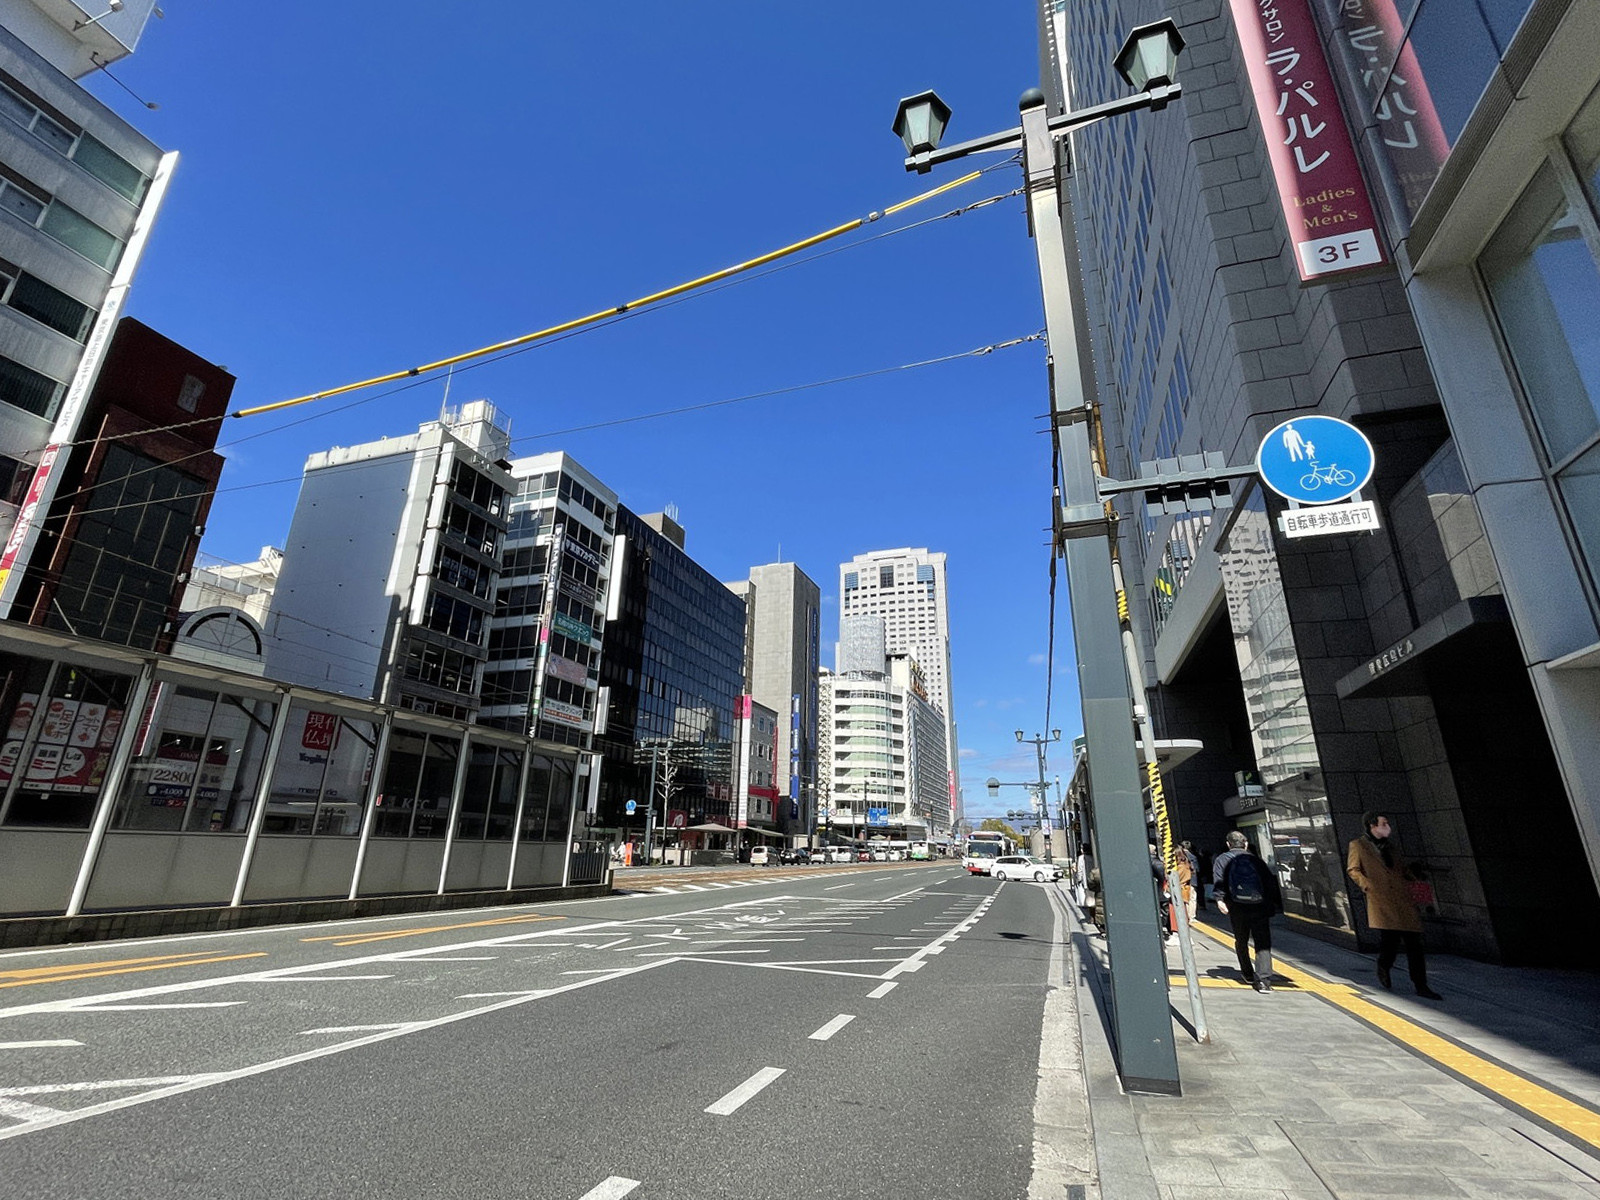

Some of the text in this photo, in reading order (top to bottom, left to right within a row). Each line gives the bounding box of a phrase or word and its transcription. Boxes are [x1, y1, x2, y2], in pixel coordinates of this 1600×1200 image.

[1259, 0, 1284, 43] サロン
[1265, 47, 1330, 173] ラ・パルレ
[1294, 187, 1355, 207] Ladies
[1321, 204, 1333, 213] &
[1303, 210, 1358, 230] Men's
[1318, 240, 1359, 263] 3F
[1287, 507, 1372, 532] 自転車歩道通行可
